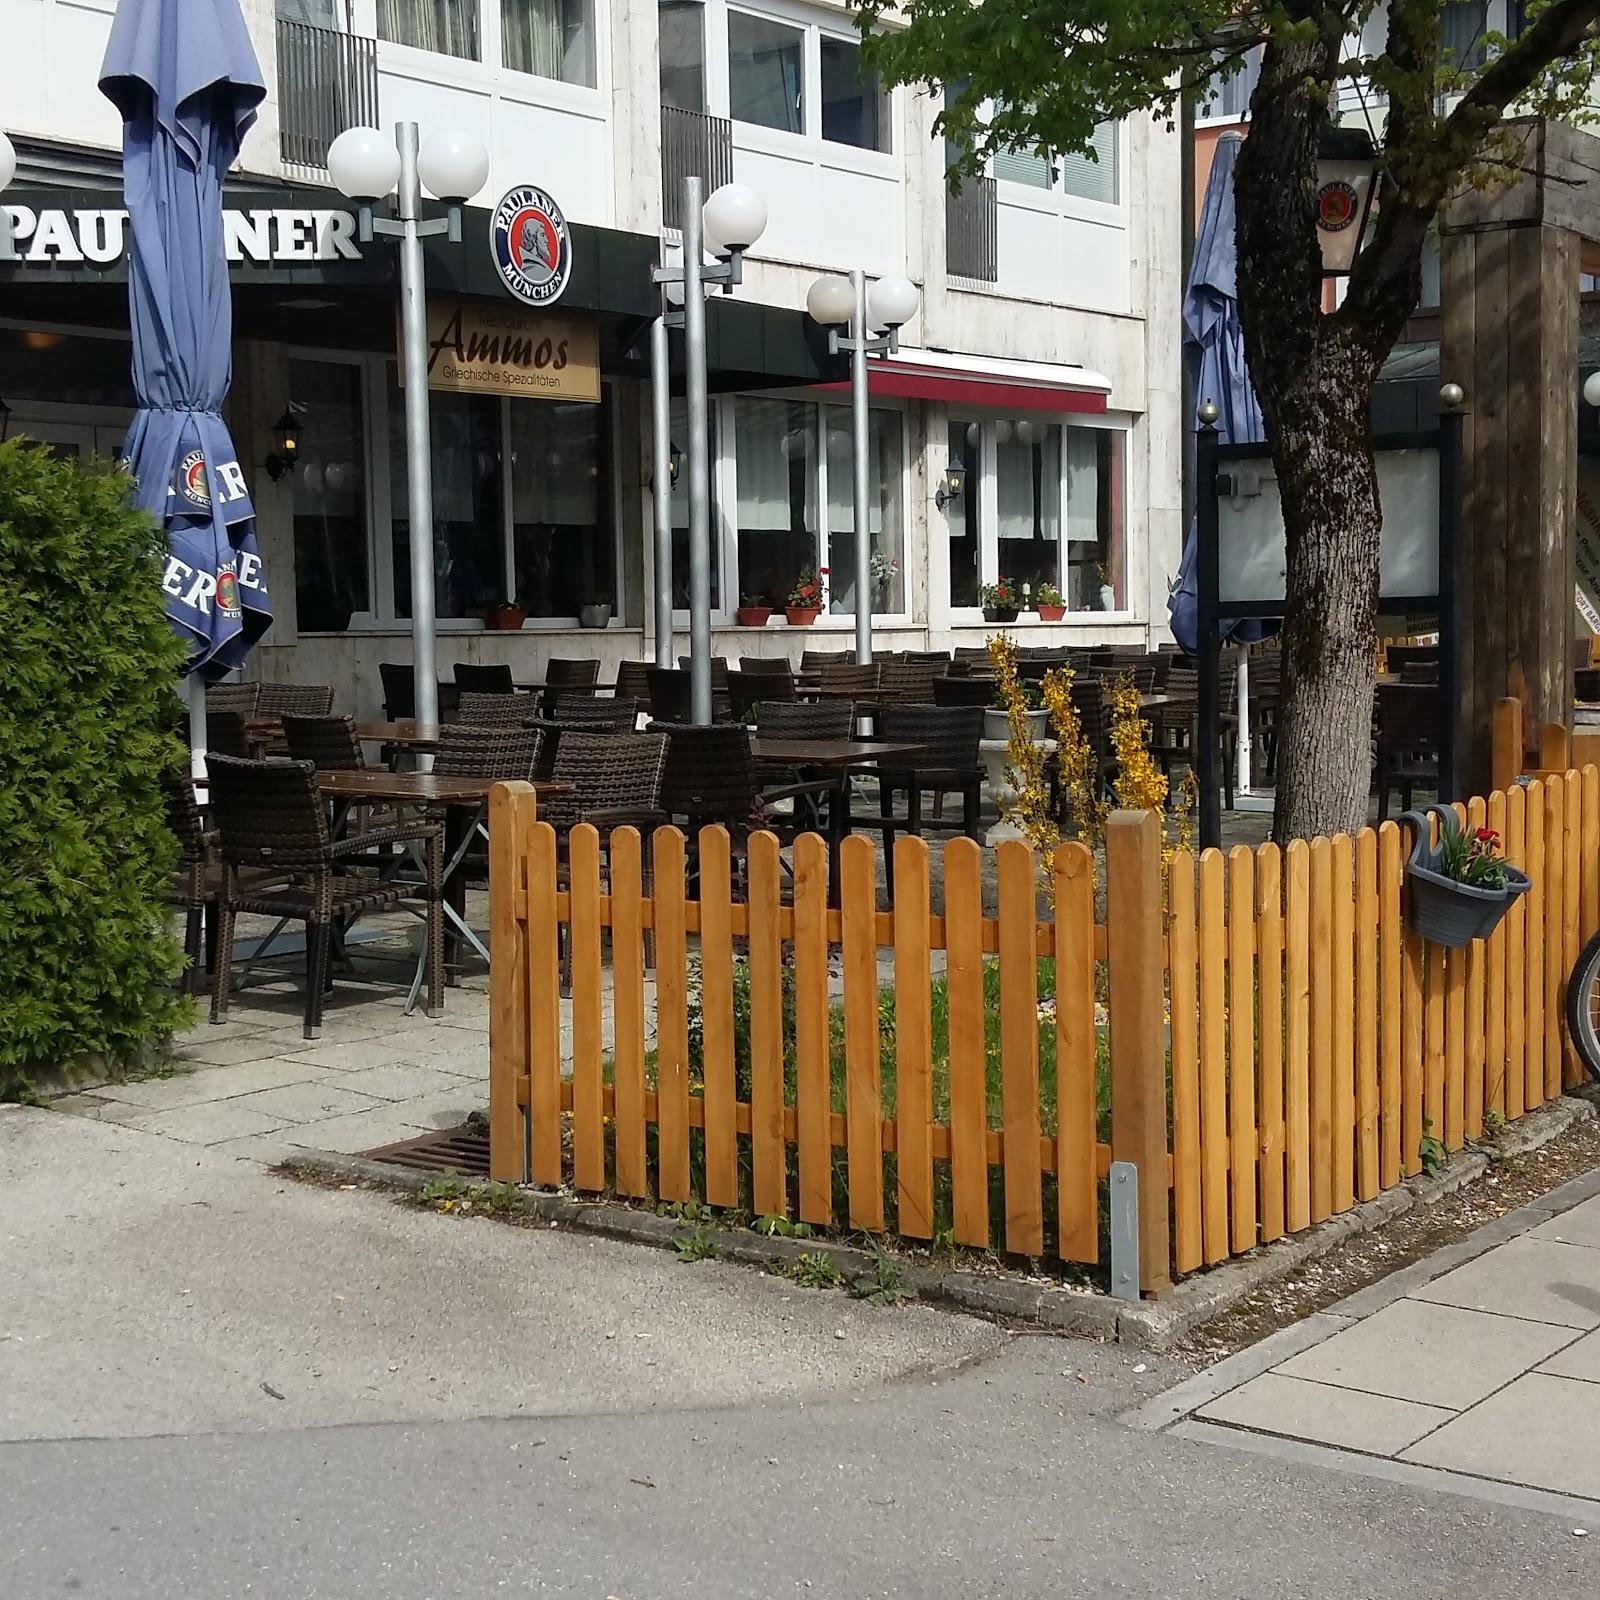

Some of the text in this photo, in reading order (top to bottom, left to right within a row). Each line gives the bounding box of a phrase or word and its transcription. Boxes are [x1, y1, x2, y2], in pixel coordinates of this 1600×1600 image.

[0, 205, 363, 262] PAUNER
[496, 190, 565, 242] PAULANER
[502, 262, 562, 299] MÜNCHEN
[427, 307, 568, 376] Ammos
[442, 365, 560, 388] Griechische Spezialitäten
[162, 555, 216, 615] ER
